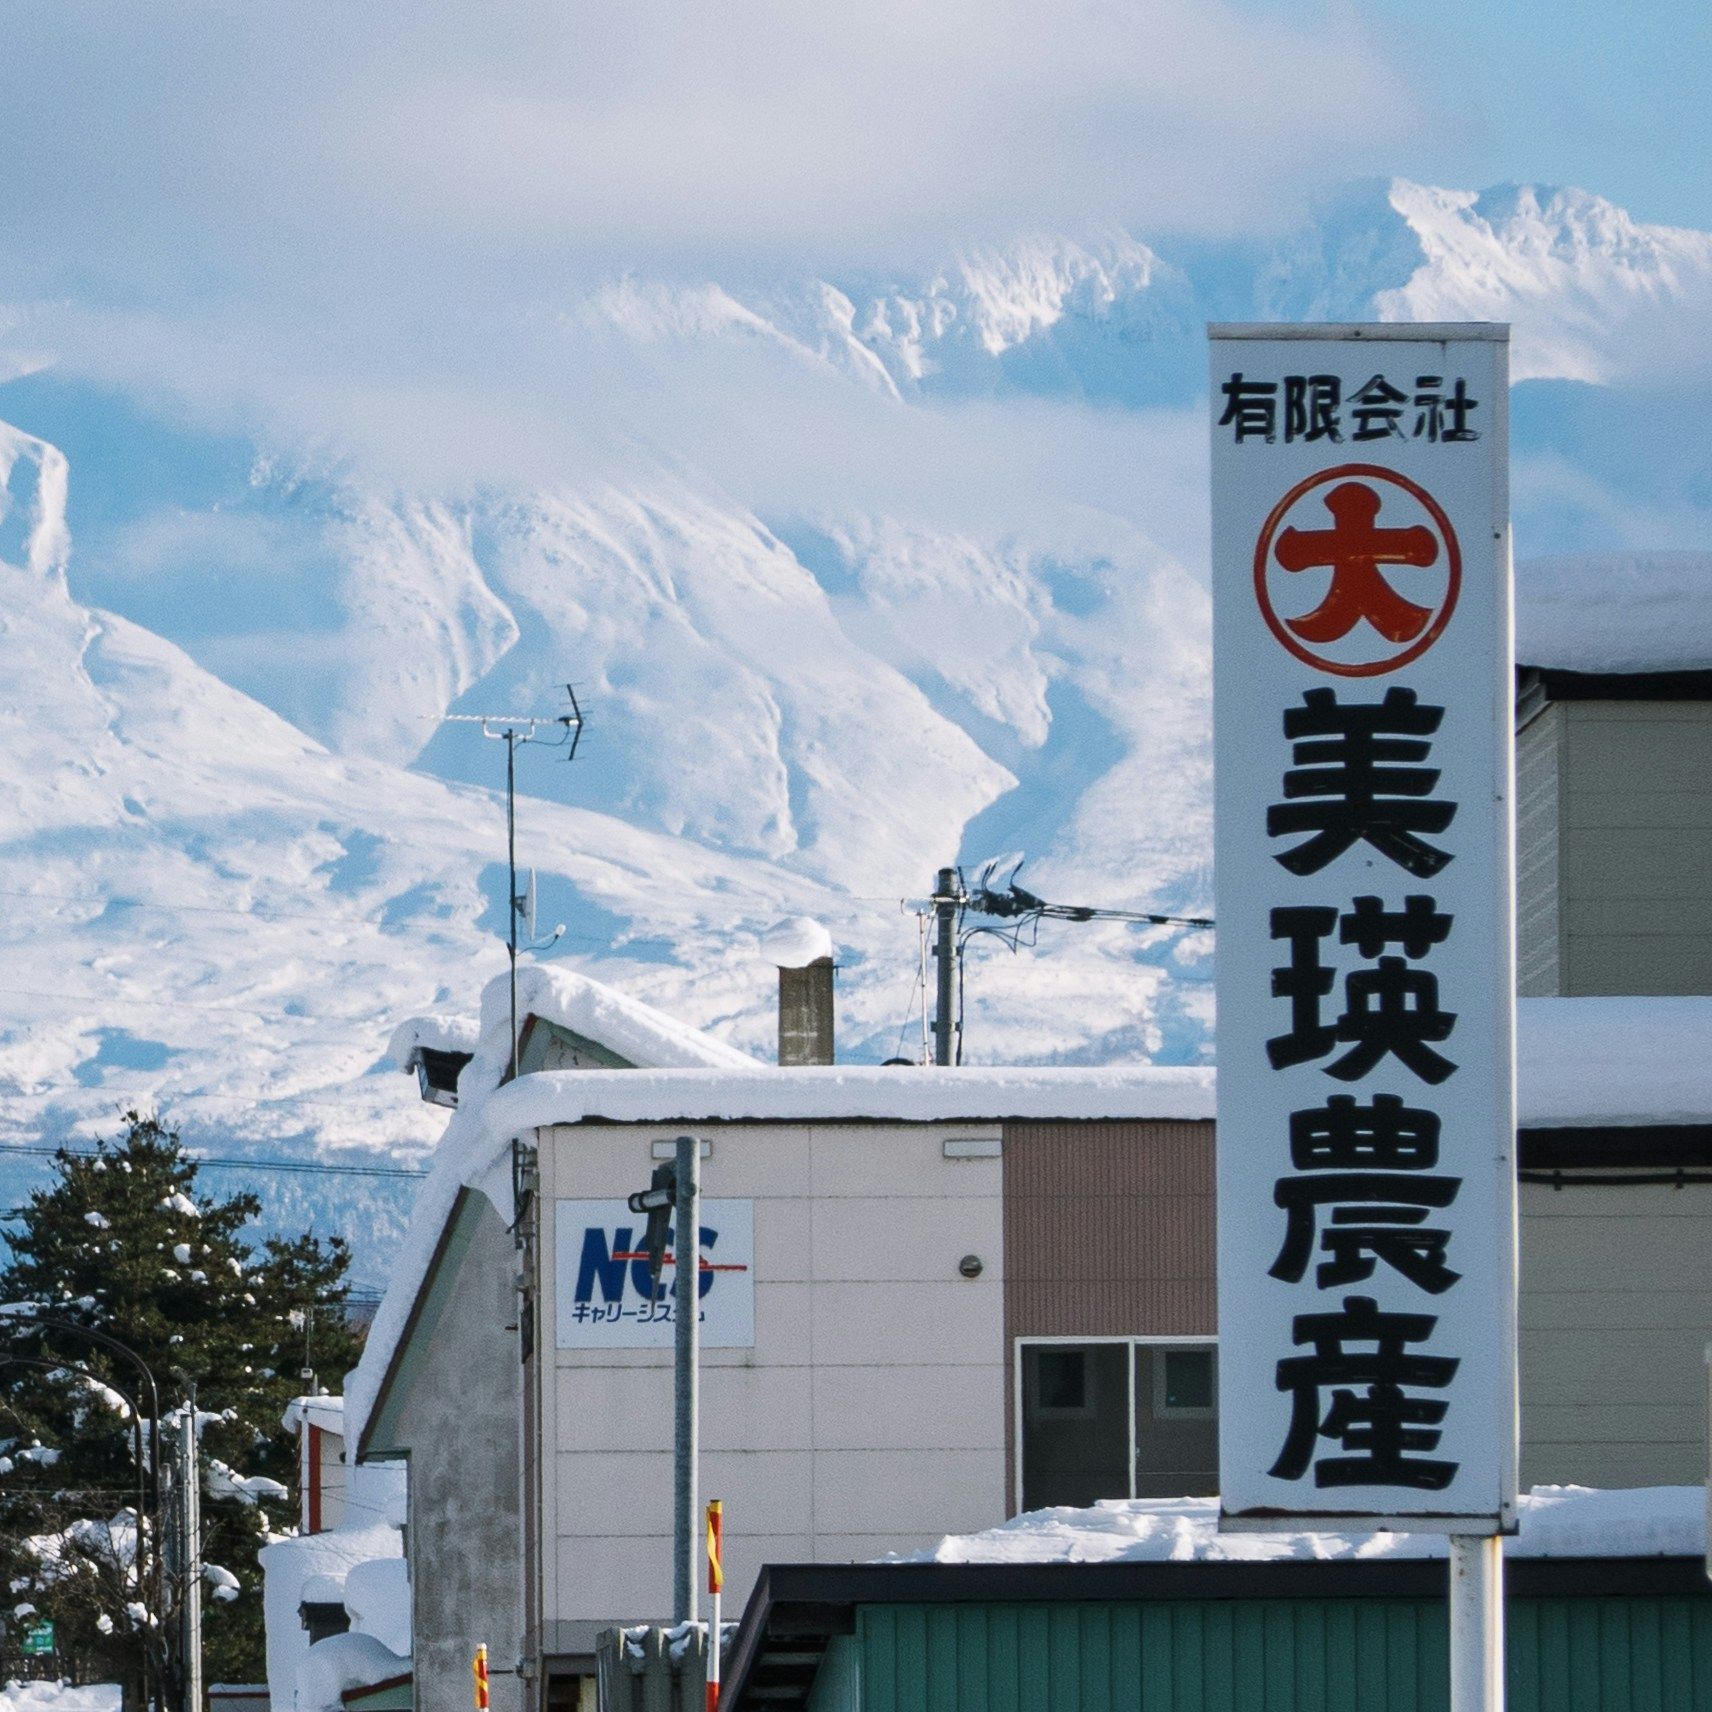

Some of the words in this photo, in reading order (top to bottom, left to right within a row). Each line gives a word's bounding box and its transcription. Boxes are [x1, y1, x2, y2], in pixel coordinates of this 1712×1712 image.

[1219, 372, 1482, 444] 有限会社
[1274, 481, 1438, 644] 大
[1266, 687, 1463, 1490] 美瑛農産
